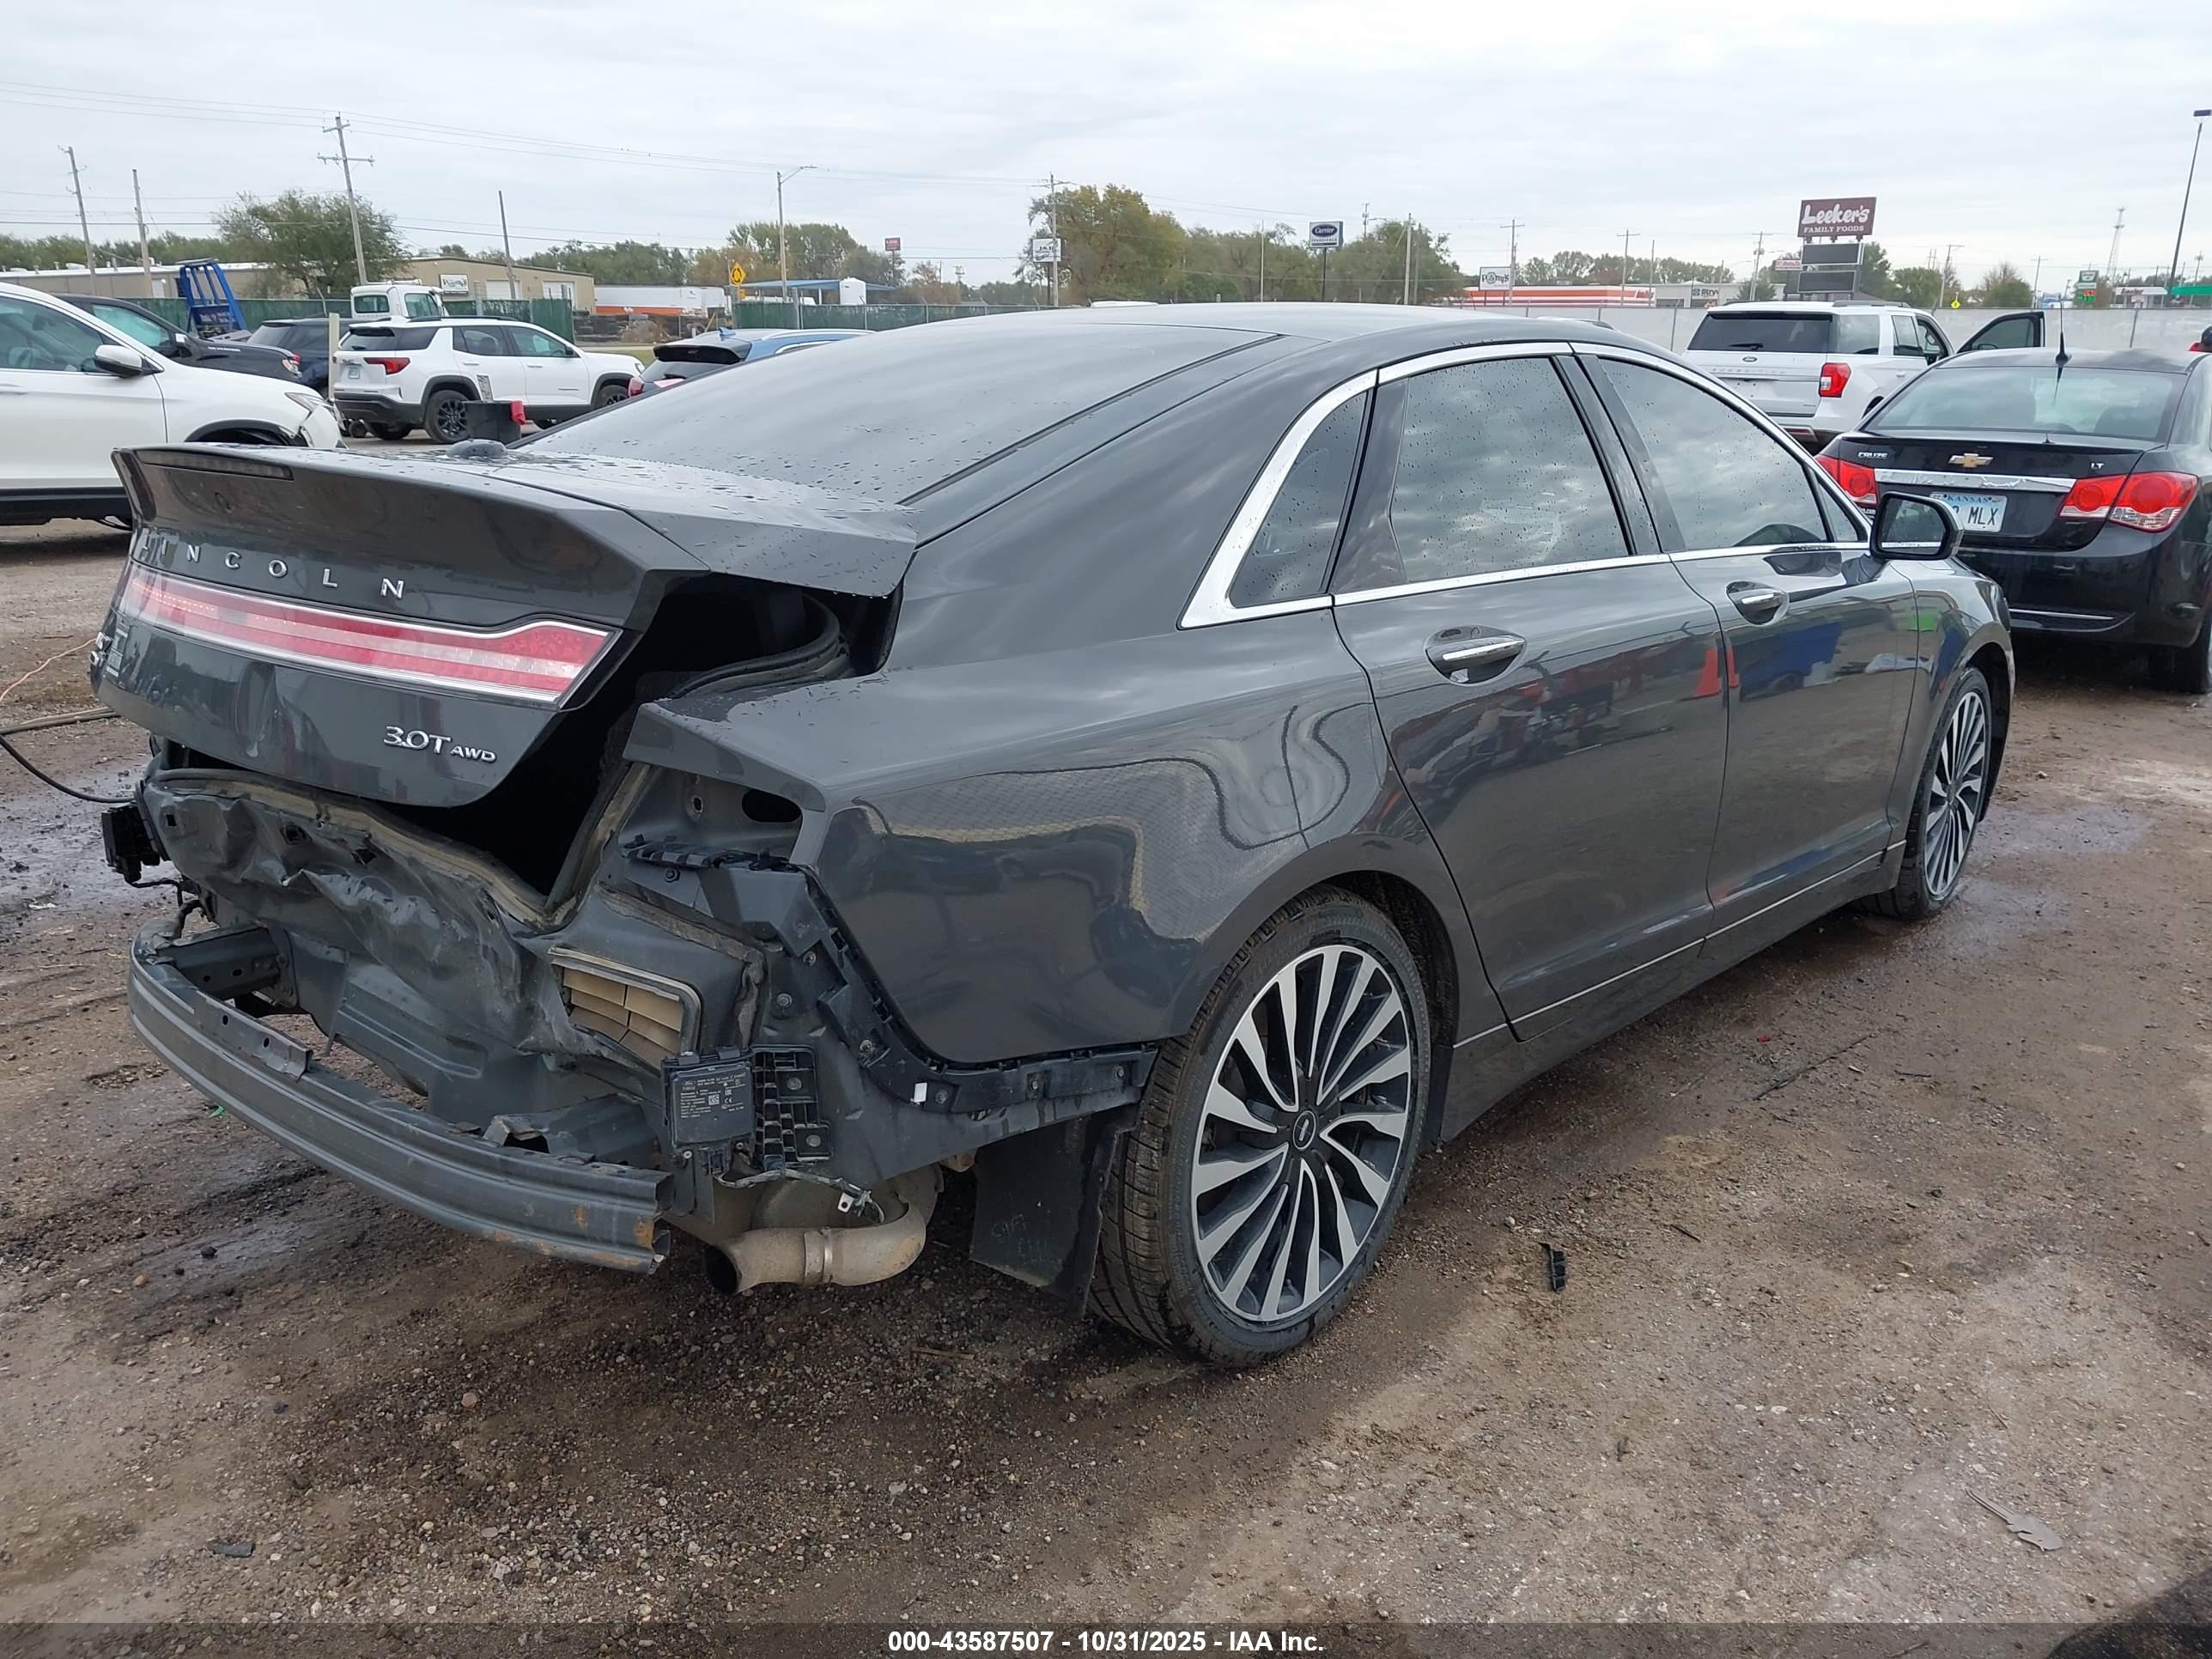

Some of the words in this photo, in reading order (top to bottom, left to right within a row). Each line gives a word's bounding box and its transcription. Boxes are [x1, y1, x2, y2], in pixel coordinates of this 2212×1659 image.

[1802, 204, 1870, 224] Leeker's
[1948, 495, 1989, 503] KANSAS
[1967, 506, 1999, 526] MLX
[383, 726, 452, 755] 3.0T
[450, 745, 496, 763] AWD
